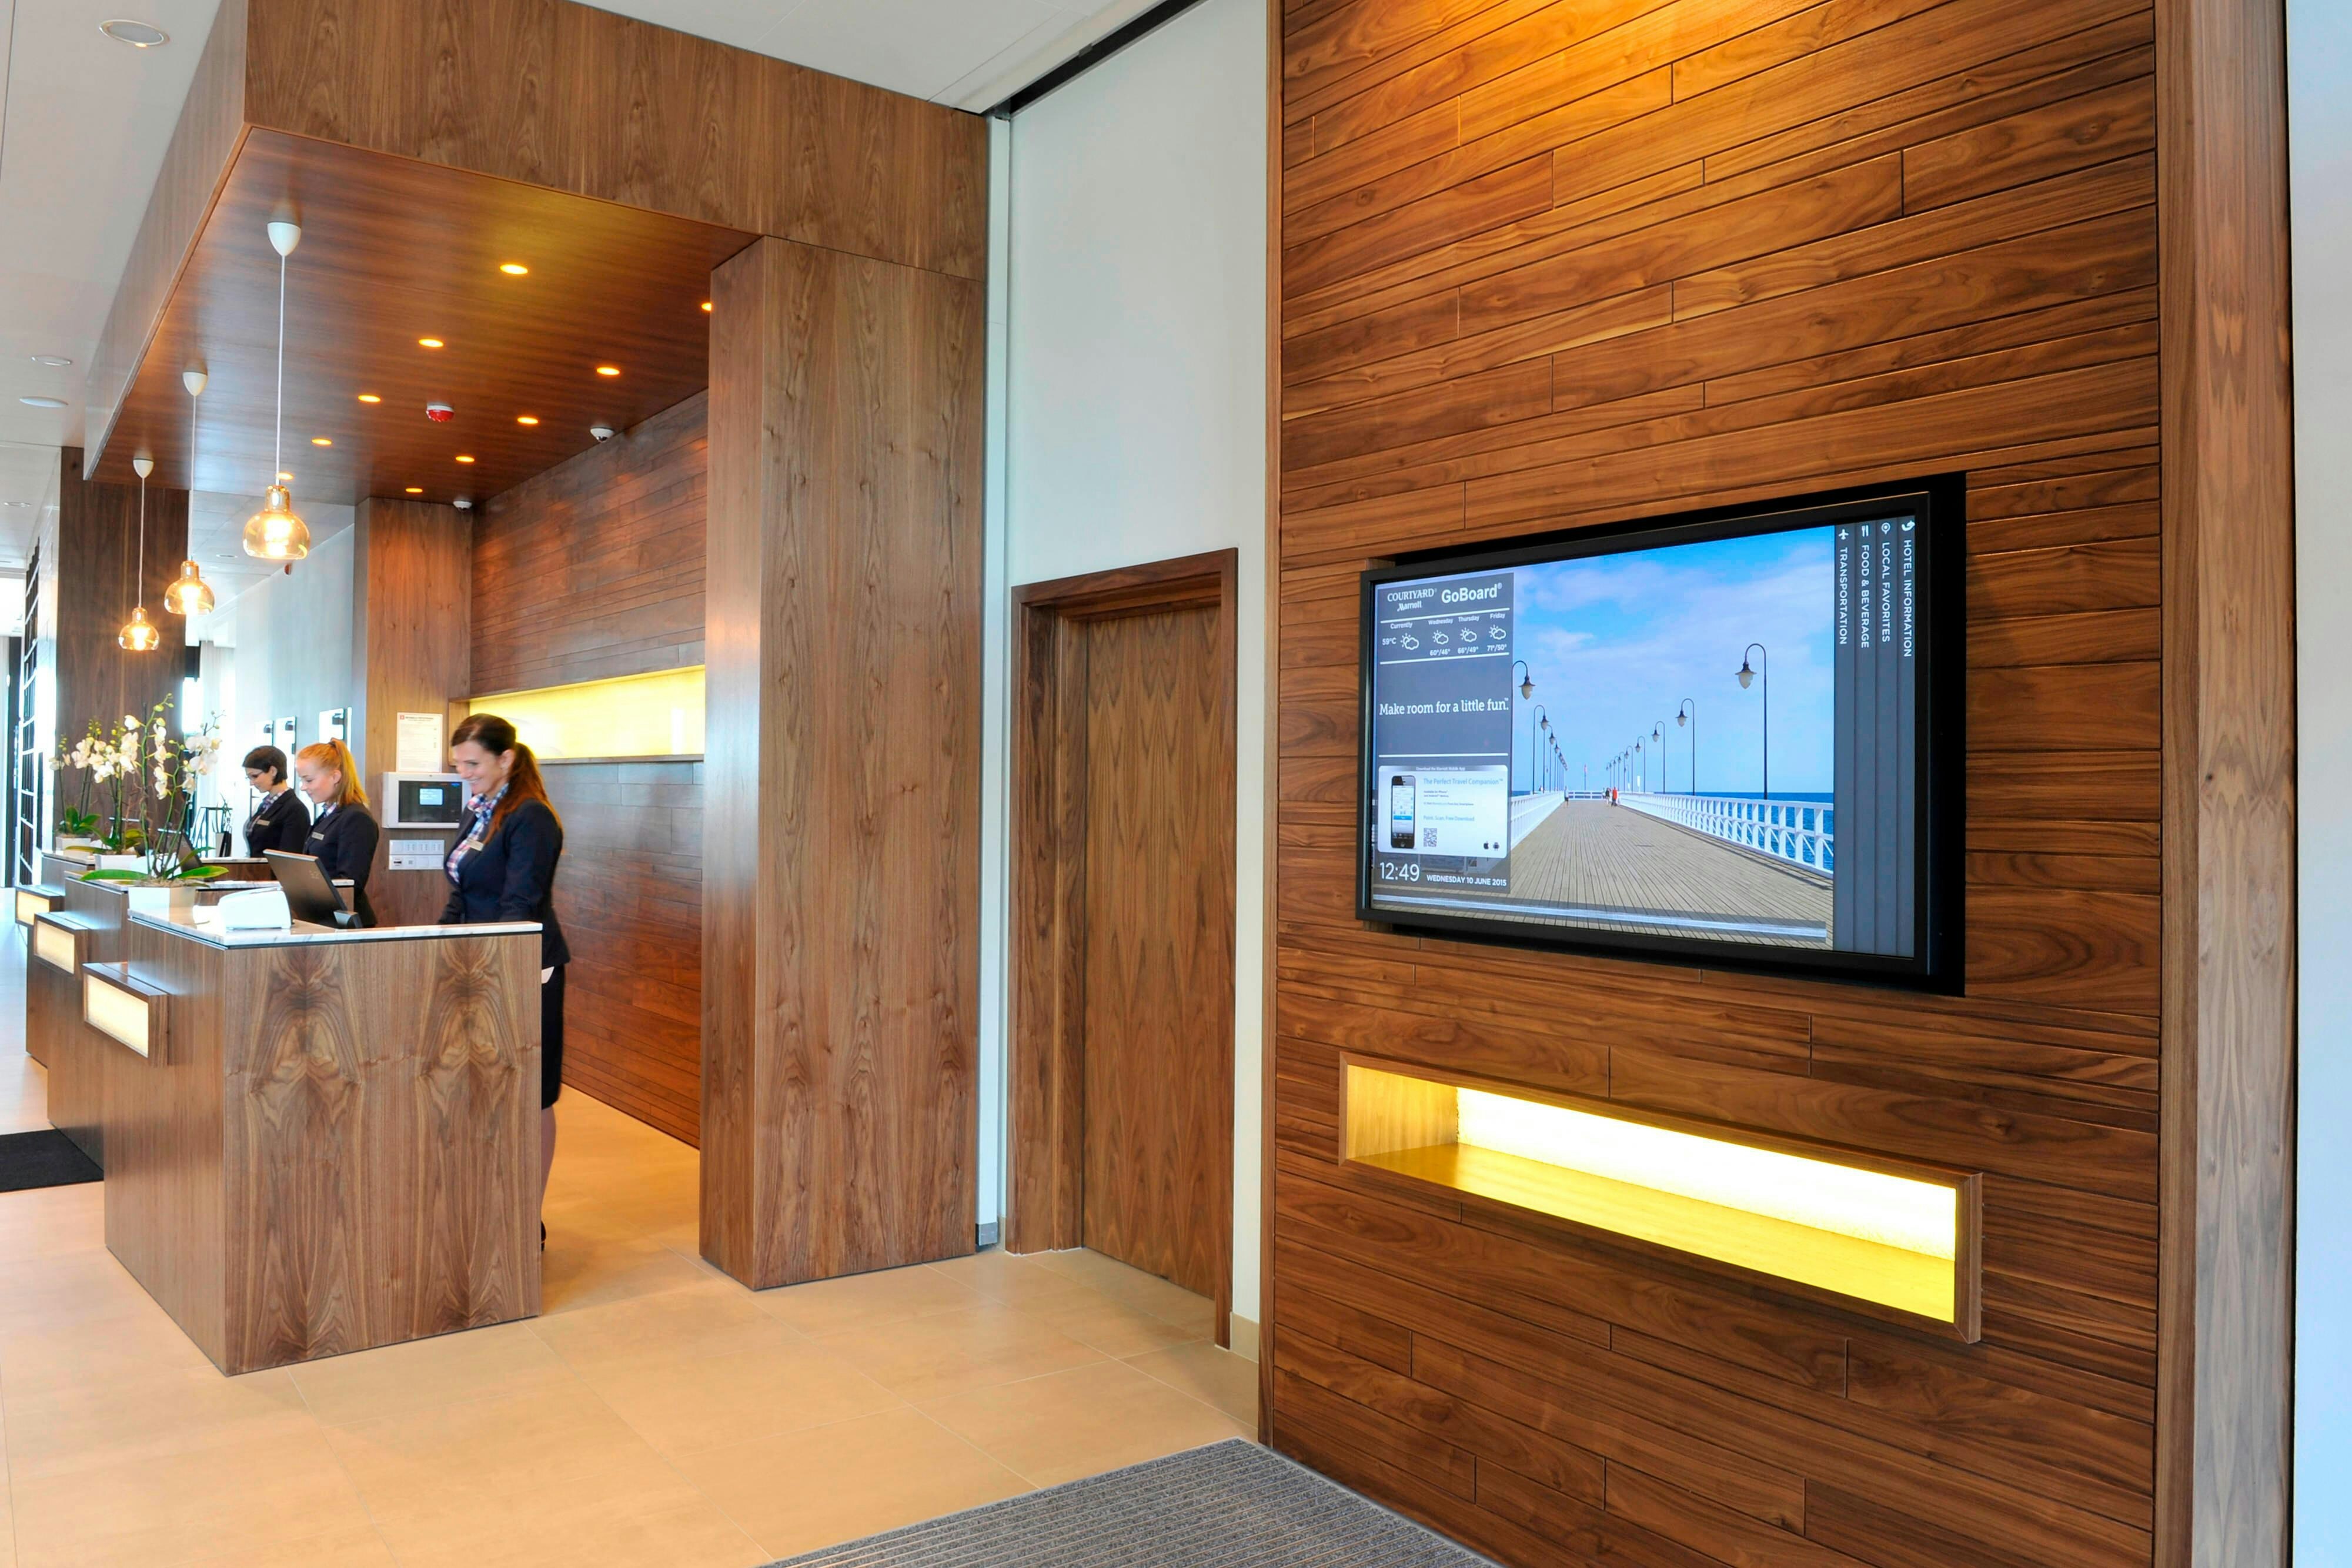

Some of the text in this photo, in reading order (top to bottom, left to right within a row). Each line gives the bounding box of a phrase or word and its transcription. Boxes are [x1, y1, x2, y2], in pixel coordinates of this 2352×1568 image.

[1861, 544, 1869, 576] FOOD
[1839, 547, 1847, 644] TRANSPORTATION
[1882, 542, 1890, 642] LOCAL FAVORITES
[1903, 540, 1912, 657] HOTEL INFORMATION
[1861, 590, 1869, 648] BEVERAGE
[1379, 703, 1405, 715] Make
[1407, 703, 1434, 714] room
[1436, 701, 1451, 713] for
[1453, 704, 1459, 713] a
[1461, 699, 1485, 711] little
[1379, 862, 1420, 882] 12:49
[1426, 874, 1465, 884] WEDNESDAY
[1492, 878, 1507, 887] 2015
